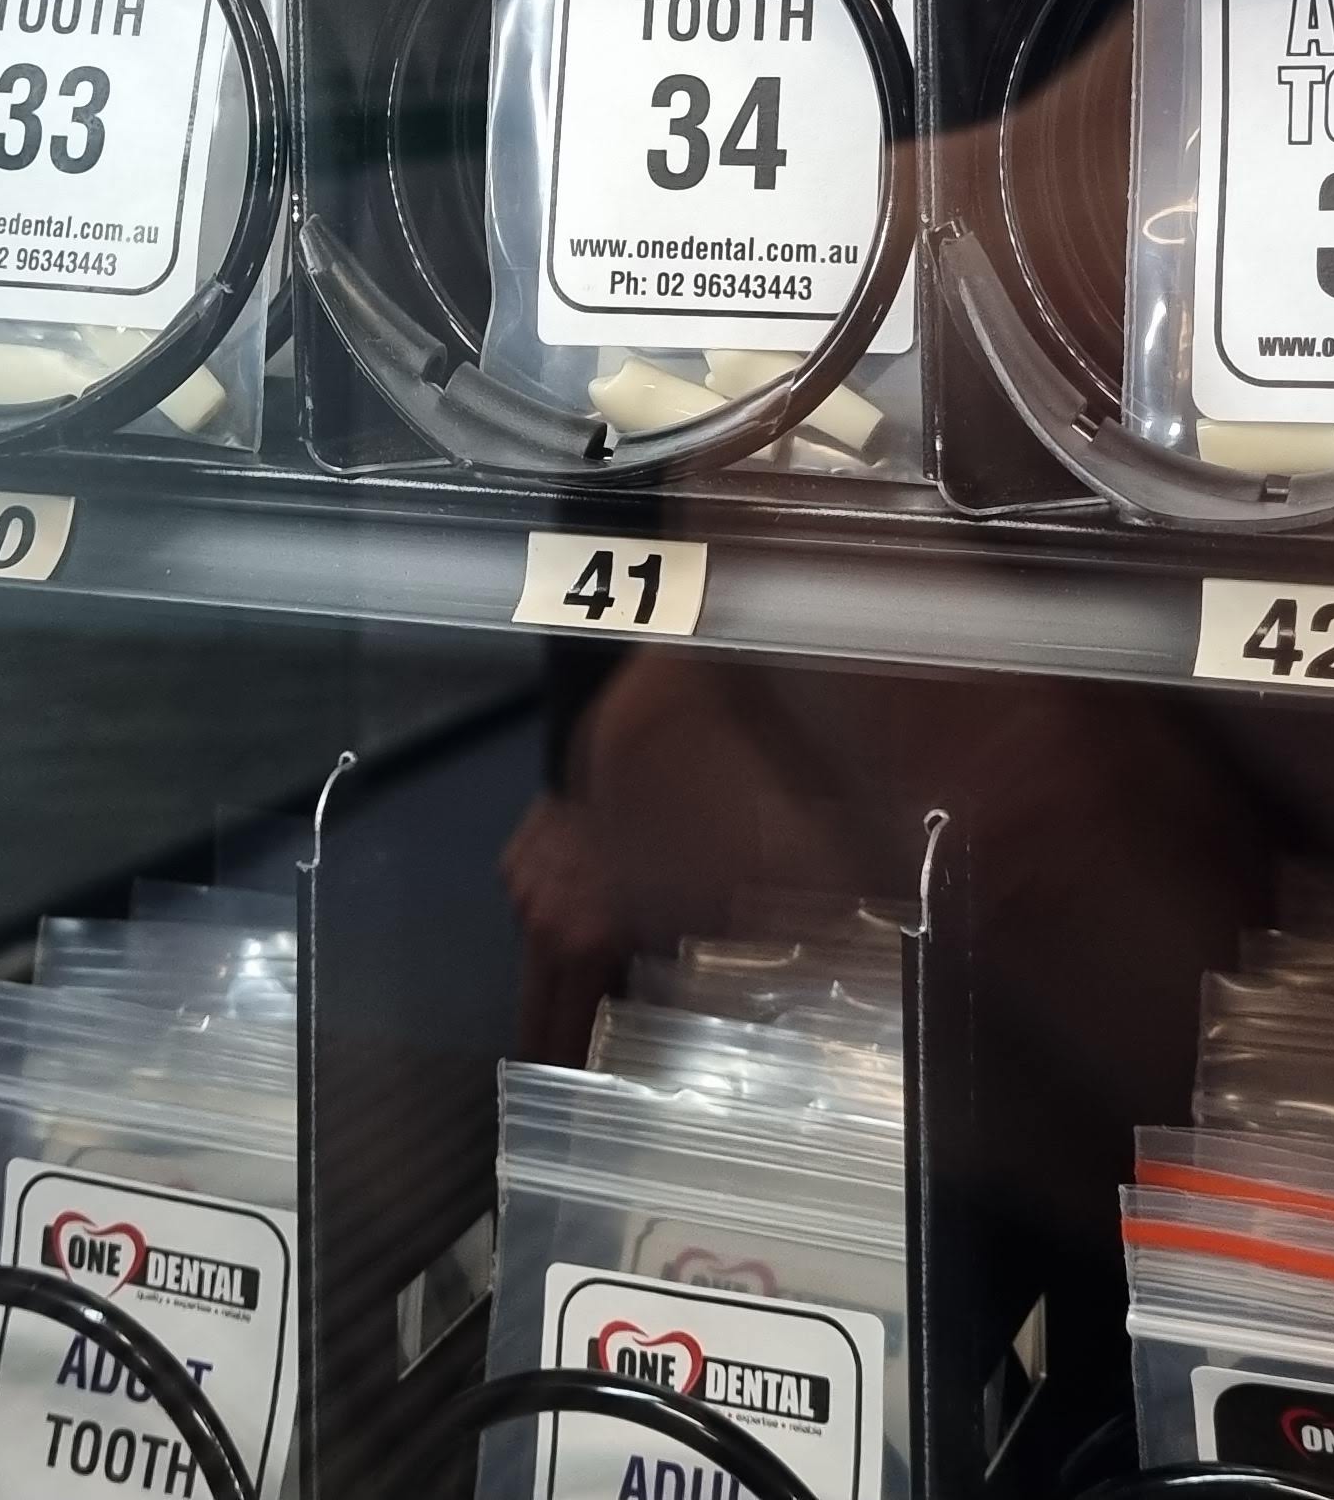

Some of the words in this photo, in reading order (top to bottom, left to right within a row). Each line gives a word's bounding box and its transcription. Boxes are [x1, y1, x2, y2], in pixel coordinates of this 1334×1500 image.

[646, 73, 788, 191] 34
[15, 247, 118, 278] 96343443
[569, 235, 860, 266] www.onedental.com.au
[609, 270, 648, 297] Ph:
[656, 271, 685, 298] 02
[692, 272, 814, 301] 96343443
[562, 549, 664, 625] 41
[68, 1234, 123, 1277] ONE
[145, 1249, 245, 1306] DENTAL
[617, 1346, 676, 1393] ONE
[705, 1360, 816, 1419] DENTAL
[46, 1412, 198, 1499] TOOTH
